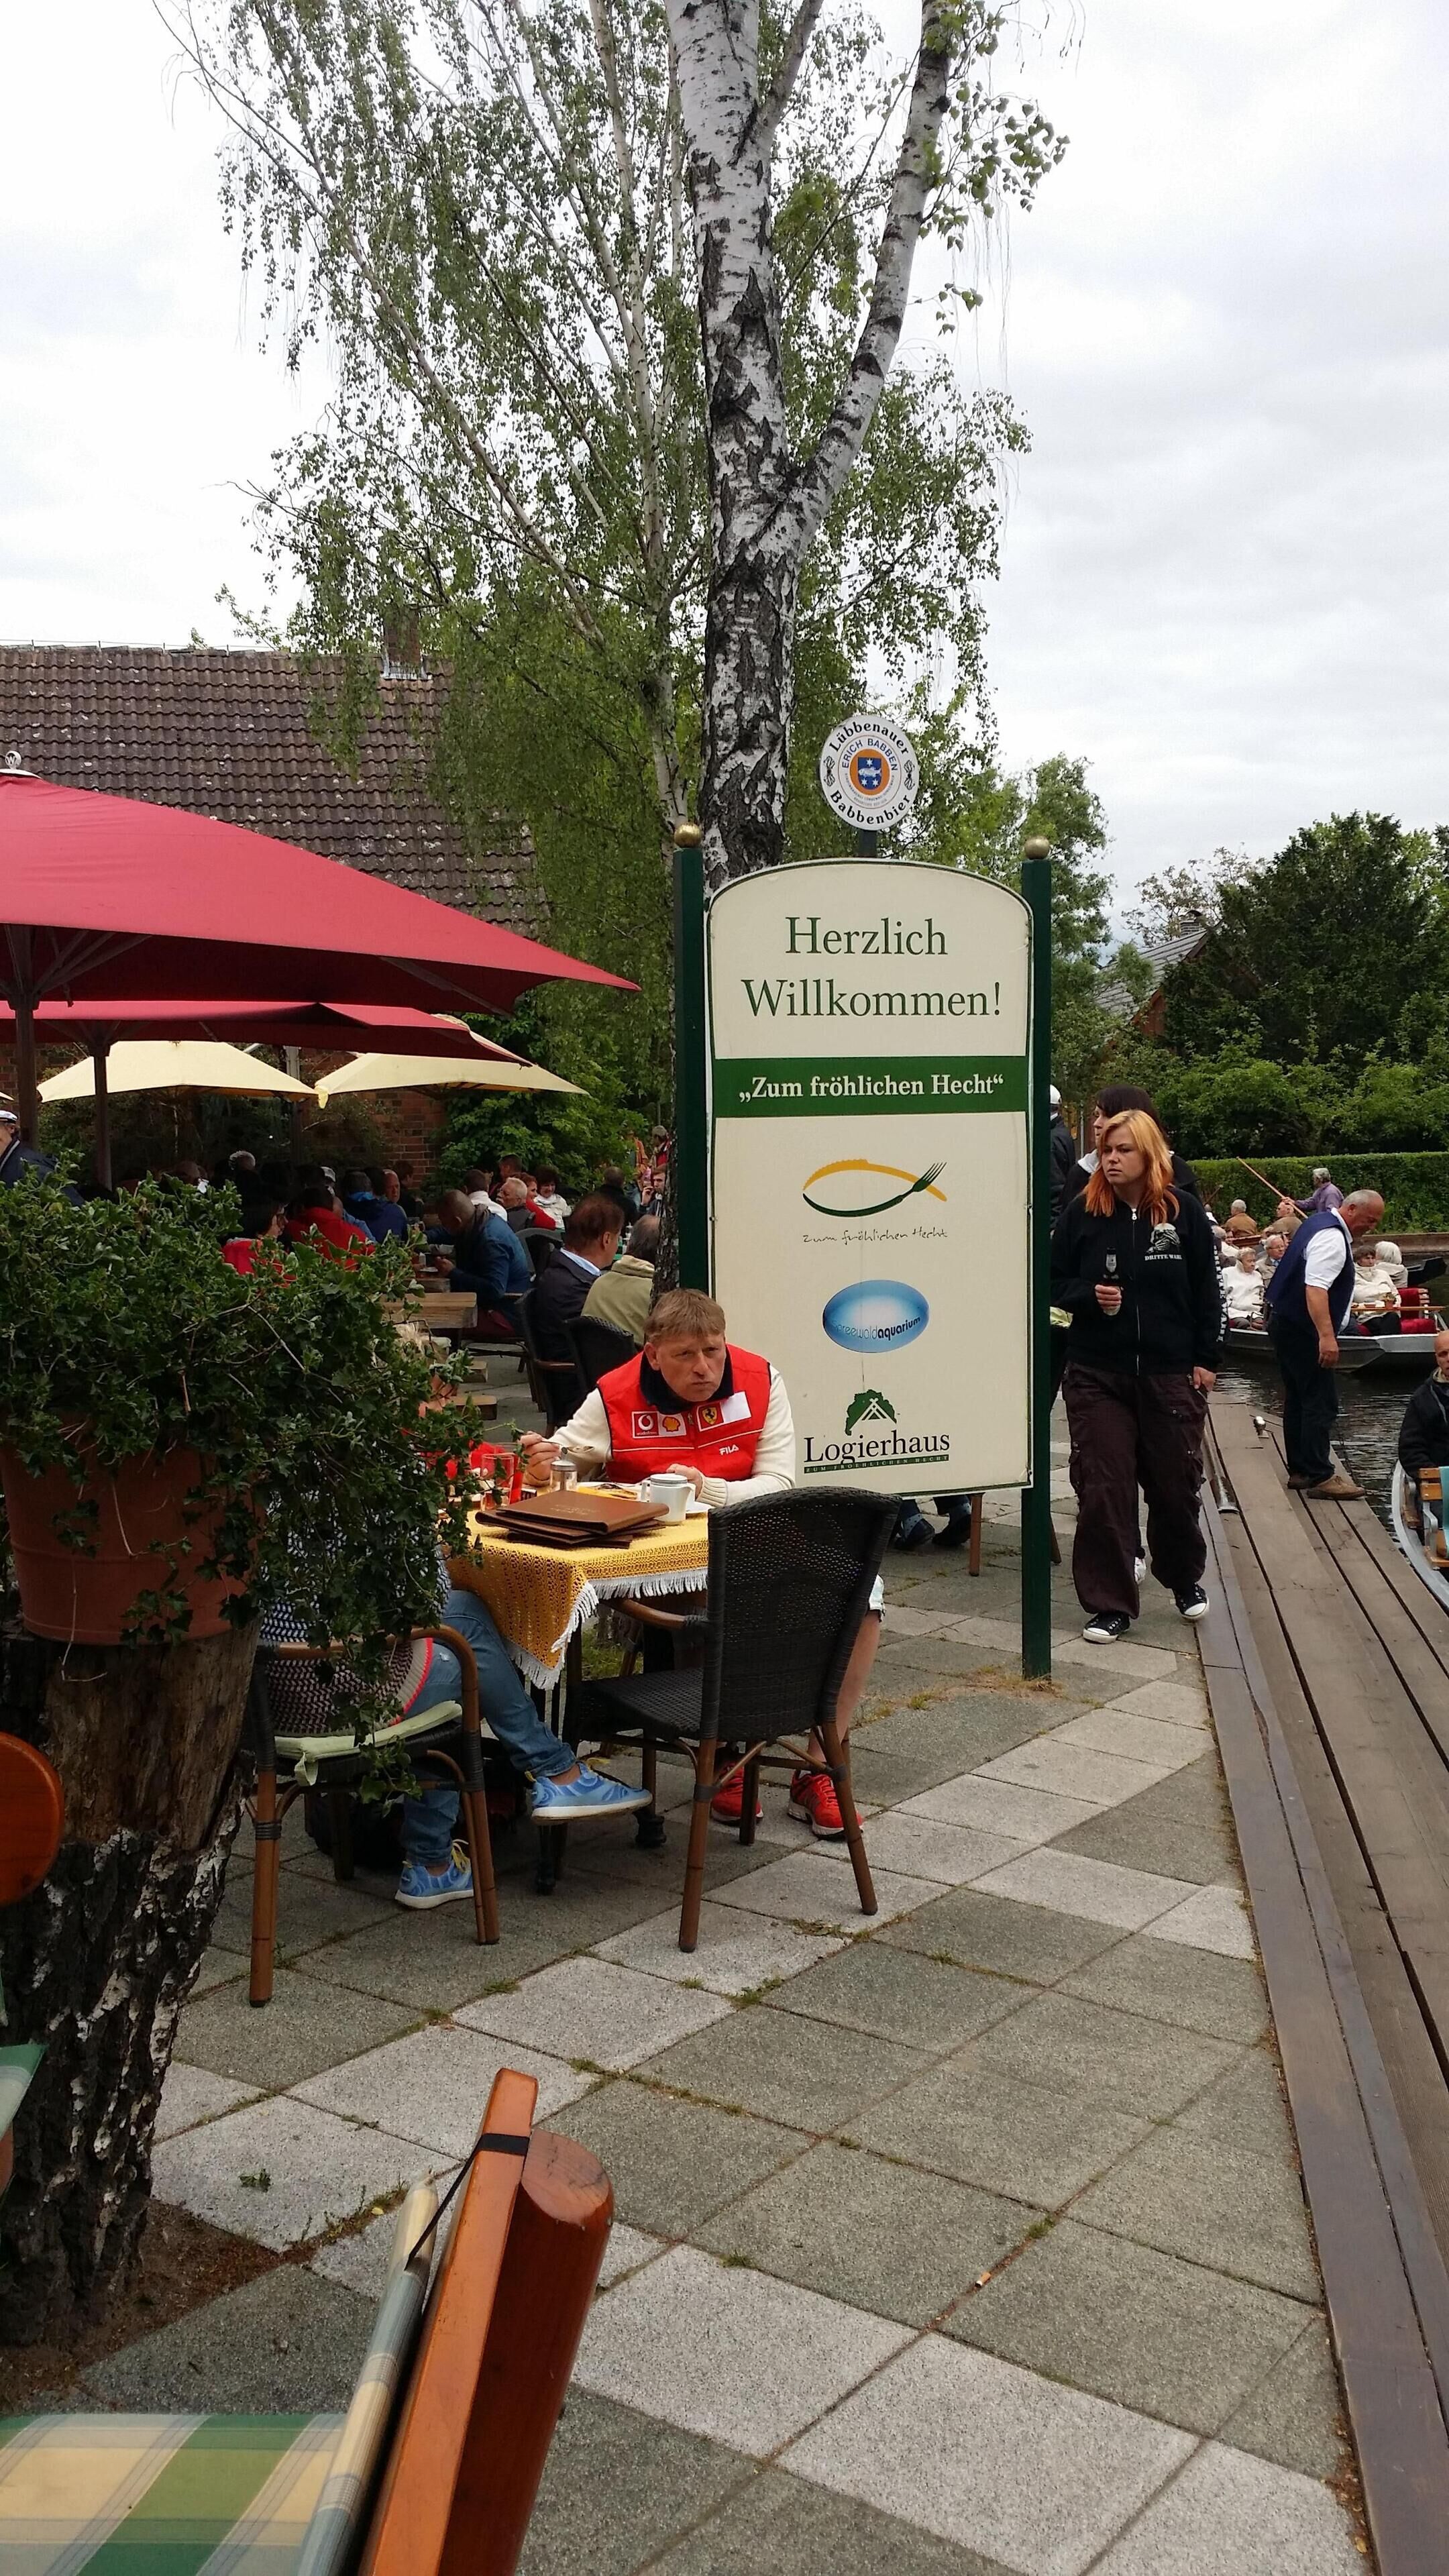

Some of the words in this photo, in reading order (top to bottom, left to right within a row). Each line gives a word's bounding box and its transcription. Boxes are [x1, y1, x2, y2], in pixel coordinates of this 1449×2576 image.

[829, 721, 909, 755] Lübbenauer
[842, 739, 863, 768] ERICH
[867, 738, 898, 771] BABBEN
[830, 790, 910, 824] Babbenbier
[785, 916, 948, 955] Herzlich
[741, 978, 1001, 1016] Willkommen!
[739, 1076, 804, 1103] „Zum
[810, 1075, 924, 1097] fröhlichen
[930, 1073, 1004, 1095] Hecht“
[841, 1229, 908, 1246] fröhlichen
[912, 1226, 948, 1238] Hecht
[719, 1444, 739, 1456] FILA
[804, 1430, 950, 1464] Logierhaus
[834, 1459, 908, 1470] FROEHLICHEN
